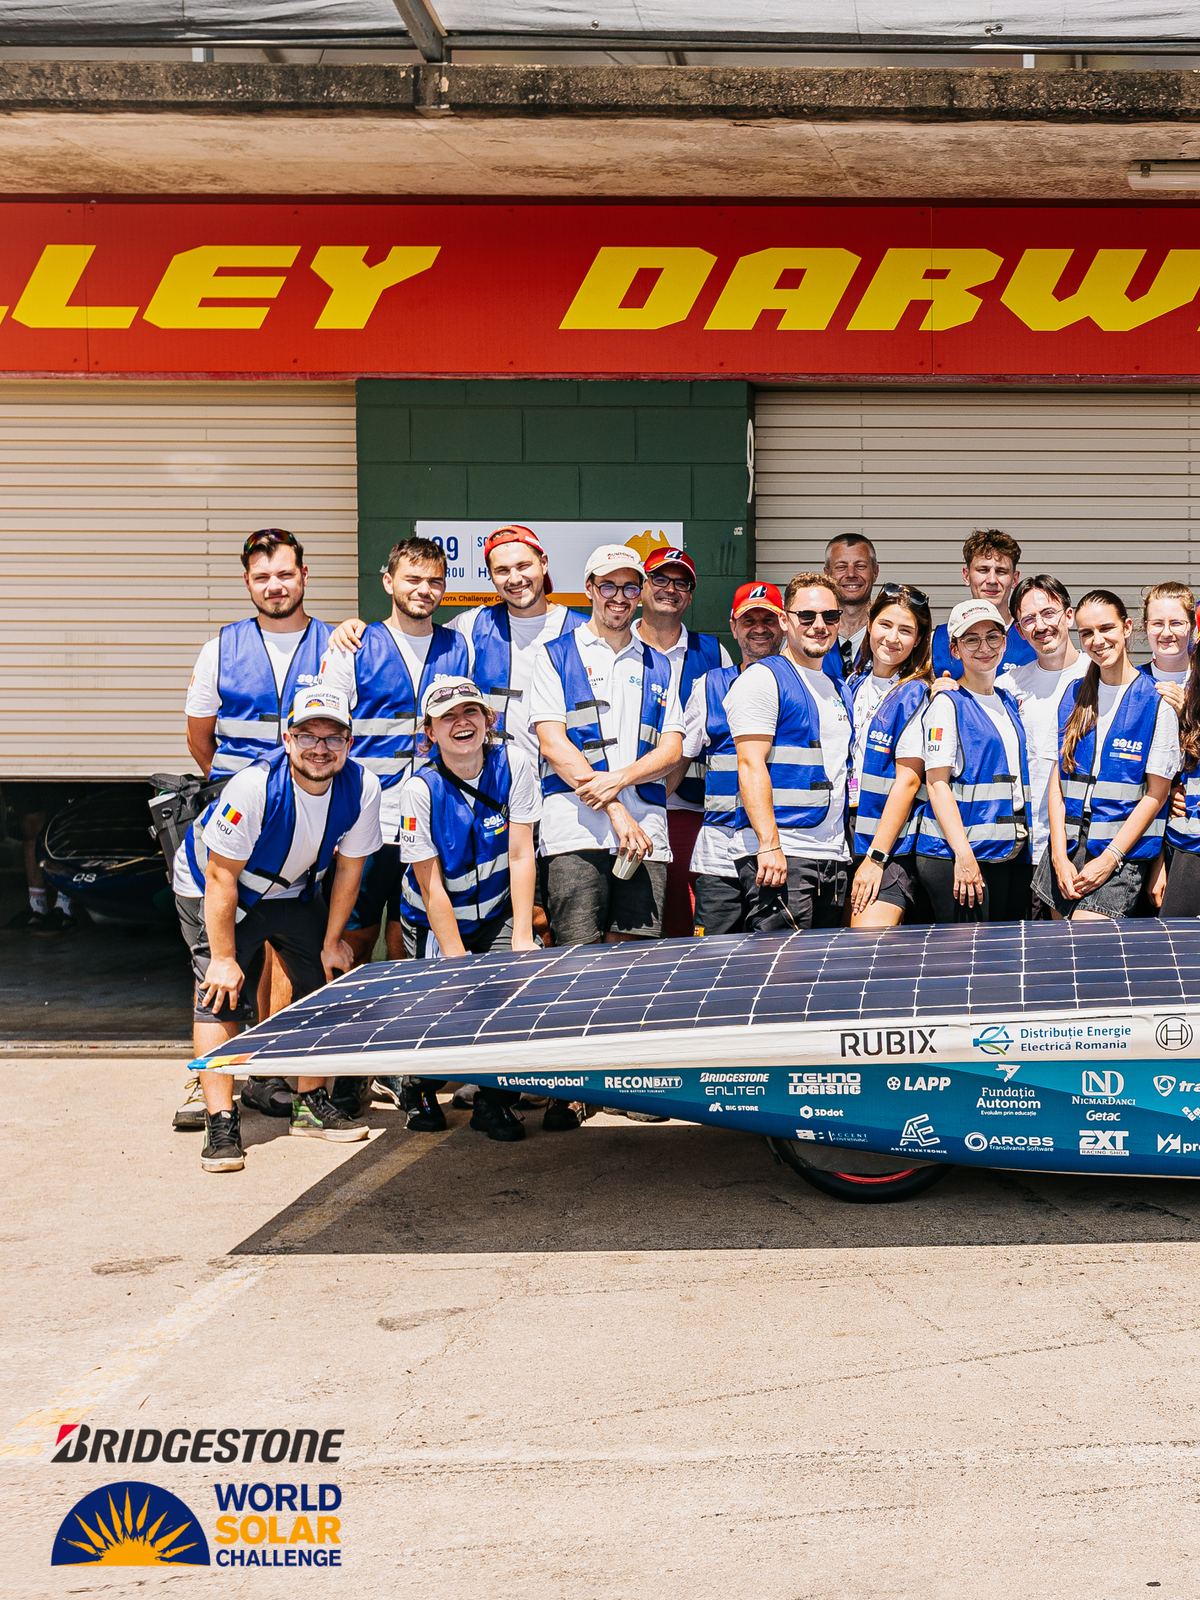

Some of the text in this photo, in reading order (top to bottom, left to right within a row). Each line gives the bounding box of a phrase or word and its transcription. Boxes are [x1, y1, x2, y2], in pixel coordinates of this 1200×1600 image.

[0, 244, 442, 329] LEY
[458, 594, 494, 604] Challenger
[1086, 1025, 1132, 1038] Energie
[840, 1028, 938, 1058] RUBIX
[1020, 1038, 1128, 1052] Electrică Romania
[699, 1072, 770, 1083] BRIDGESTONE
[788, 1072, 861, 1083] TEHNO
[903, 1076, 951, 1091] LAPP
[705, 1085, 766, 1096] ENLITEN
[737, 1104, 760, 1112] STORE
[976, 1096, 1042, 1109] Autonom
[1085, 1109, 1122, 1122] Getac
[989, 1135, 1055, 1147] AROBS
[1078, 1130, 1130, 1150] EXT
